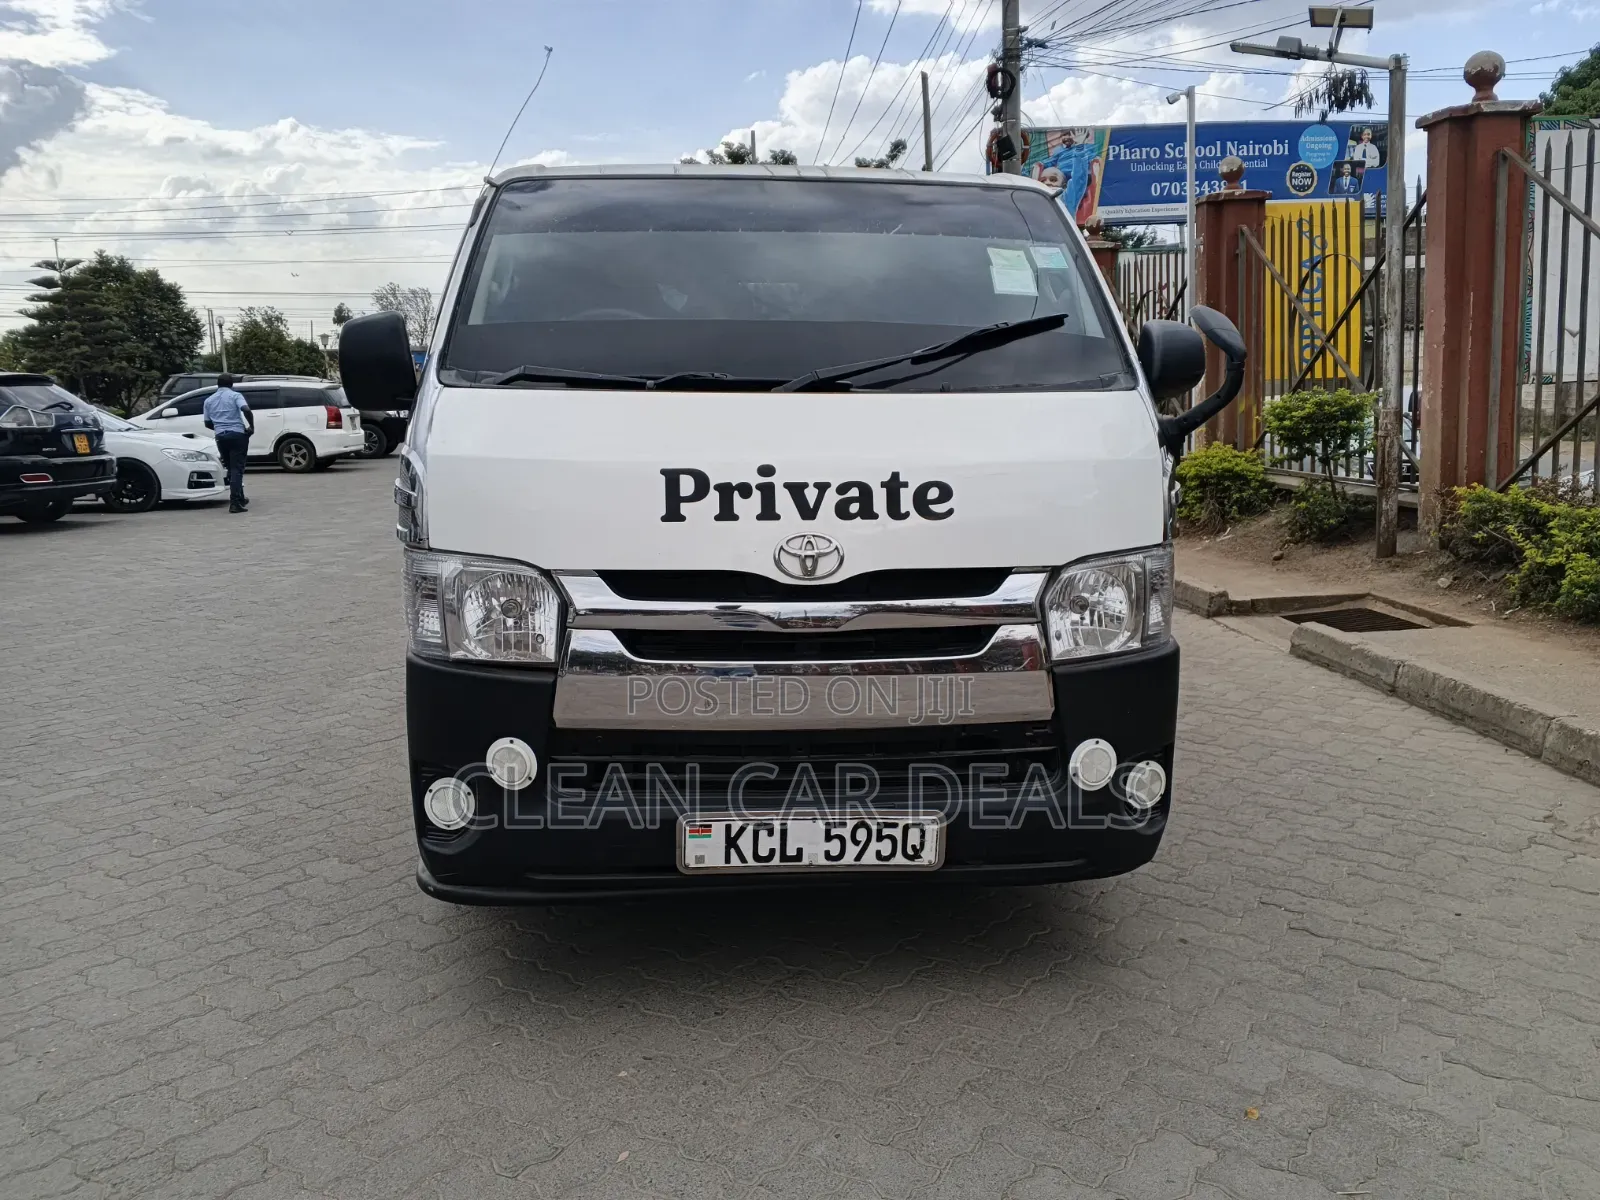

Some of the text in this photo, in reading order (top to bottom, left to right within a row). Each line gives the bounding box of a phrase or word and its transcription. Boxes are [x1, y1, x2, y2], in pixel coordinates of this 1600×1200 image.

[1108, 144, 1160, 160] Pharo
[1226, 139, 1289, 156] Nairobi
[1306, 142, 1332, 150] Ongoing
[1130, 162, 1175, 172] Unlocking
[1151, 179, 1247, 196] 070354381
[1292, 178, 1312, 186] NOW
[660, 464, 955, 522] Private
[724, 820, 927, 864] KCL 595Q
